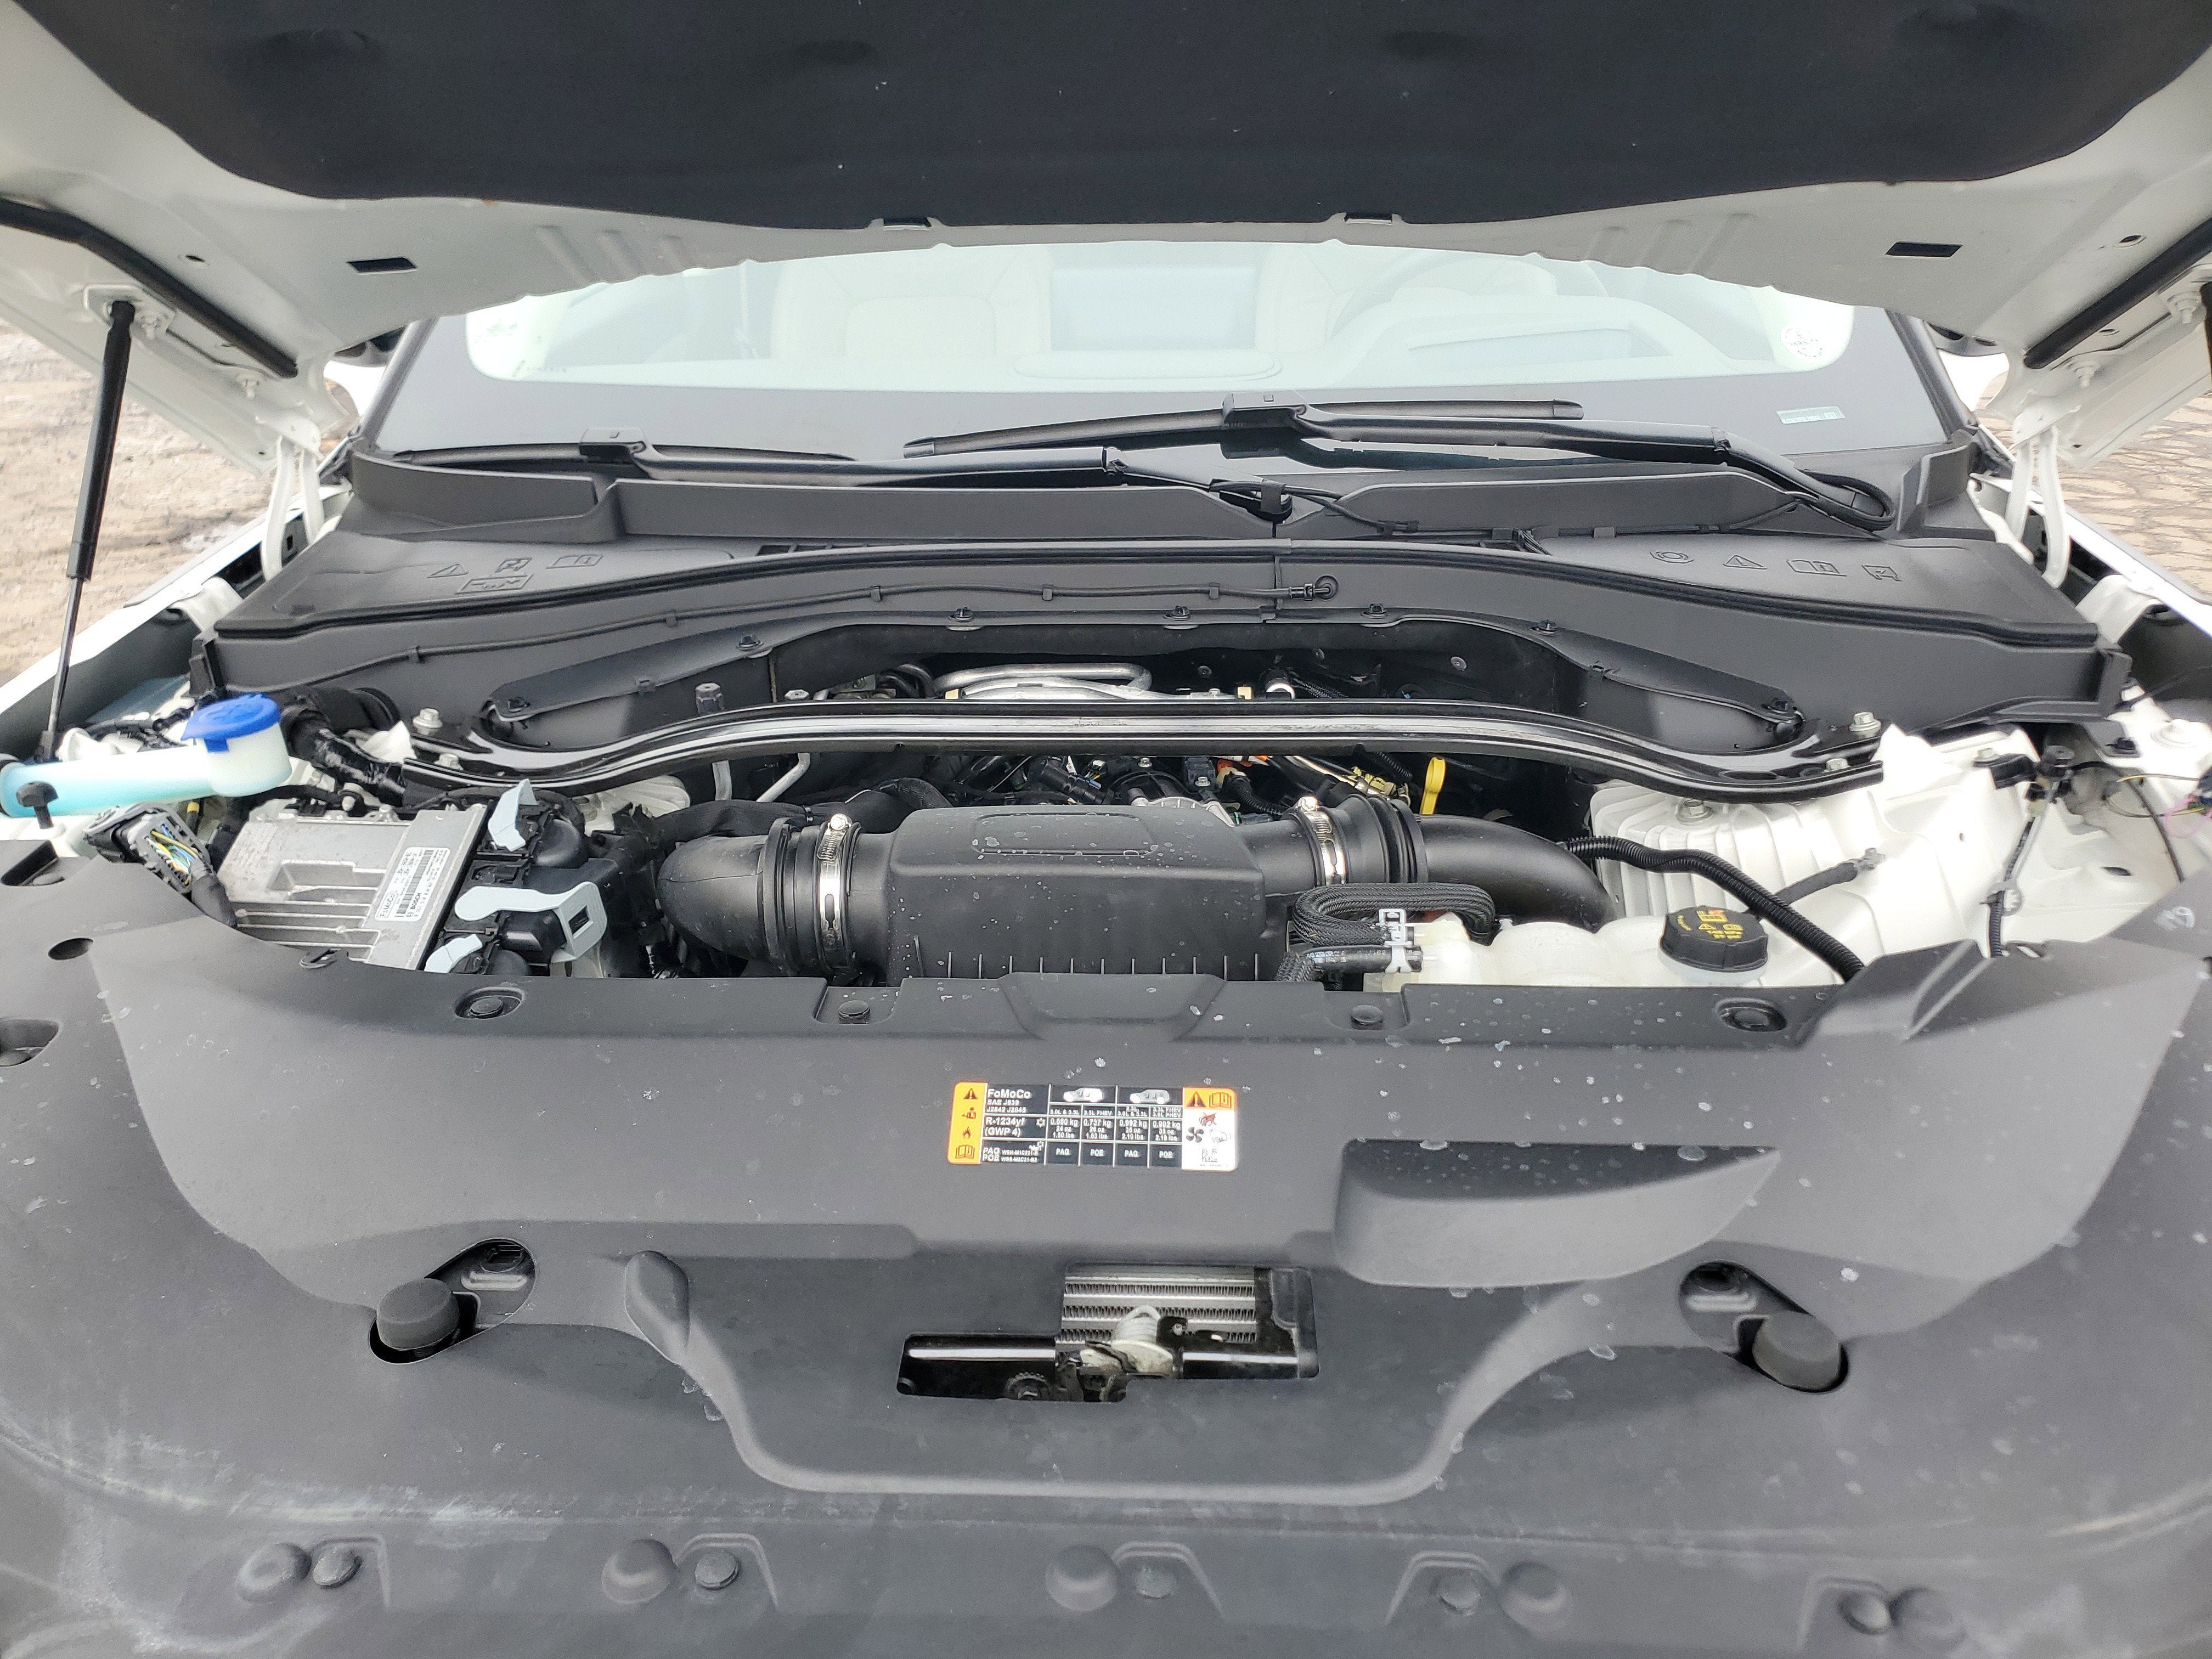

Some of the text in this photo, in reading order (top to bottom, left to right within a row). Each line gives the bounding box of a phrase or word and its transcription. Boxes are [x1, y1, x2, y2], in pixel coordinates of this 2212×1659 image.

[988, 1088, 1031, 1099] FoMoCo
[985, 1116, 1026, 1128] R-1234yf
[1069, 1118, 1078, 1127] kg
[1103, 1119, 1111, 1128] kg
[1138, 1120, 1147, 1129] kg
[1172, 1121, 1181, 1130] kg
[984, 1127, 1021, 1137] (GWP 4)
[1056, 1148, 1069, 1156] PAG
[1159, 1150, 1173, 1159] POE
[982, 1154, 1000, 1162] POE
